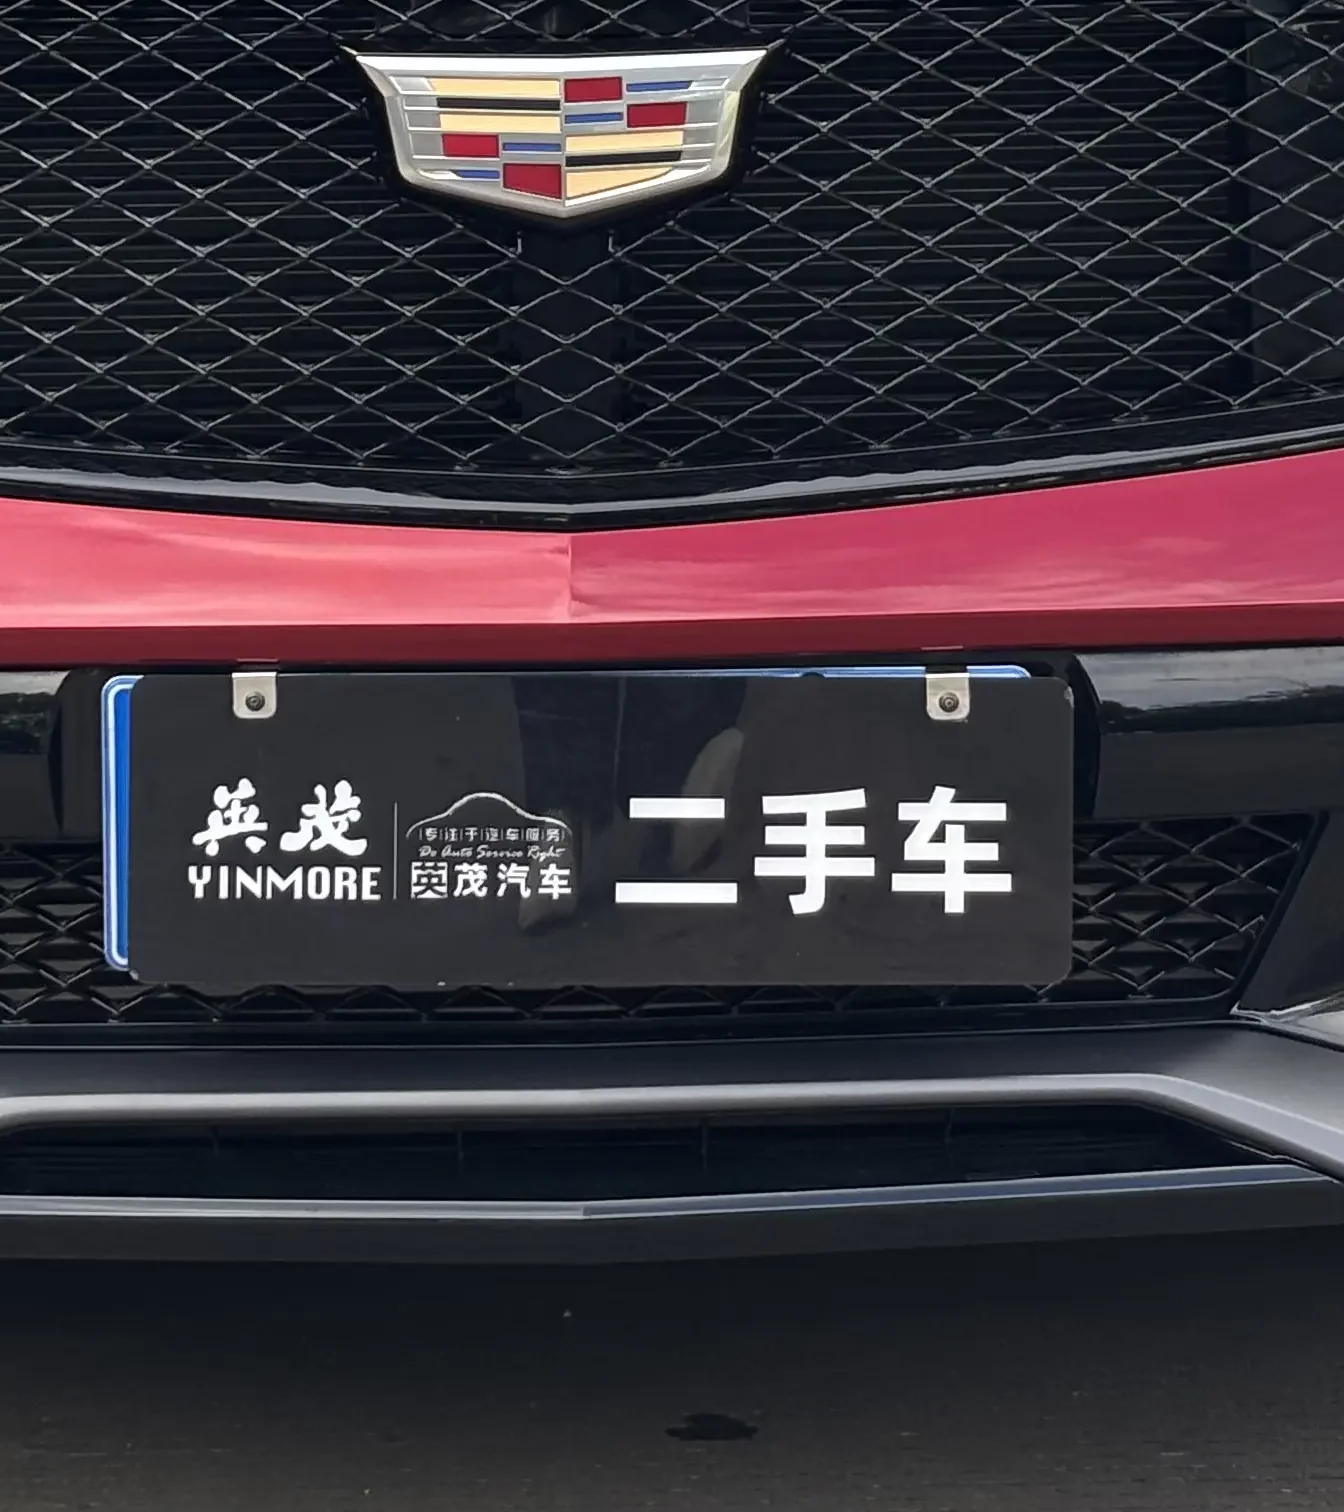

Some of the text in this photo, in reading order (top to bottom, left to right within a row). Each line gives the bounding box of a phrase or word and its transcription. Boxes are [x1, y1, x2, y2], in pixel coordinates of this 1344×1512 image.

[615, 785, 1013, 915] 二手车
[188, 865, 382, 900] YINMORE
[411, 861, 573, 900] 英茂汽车
